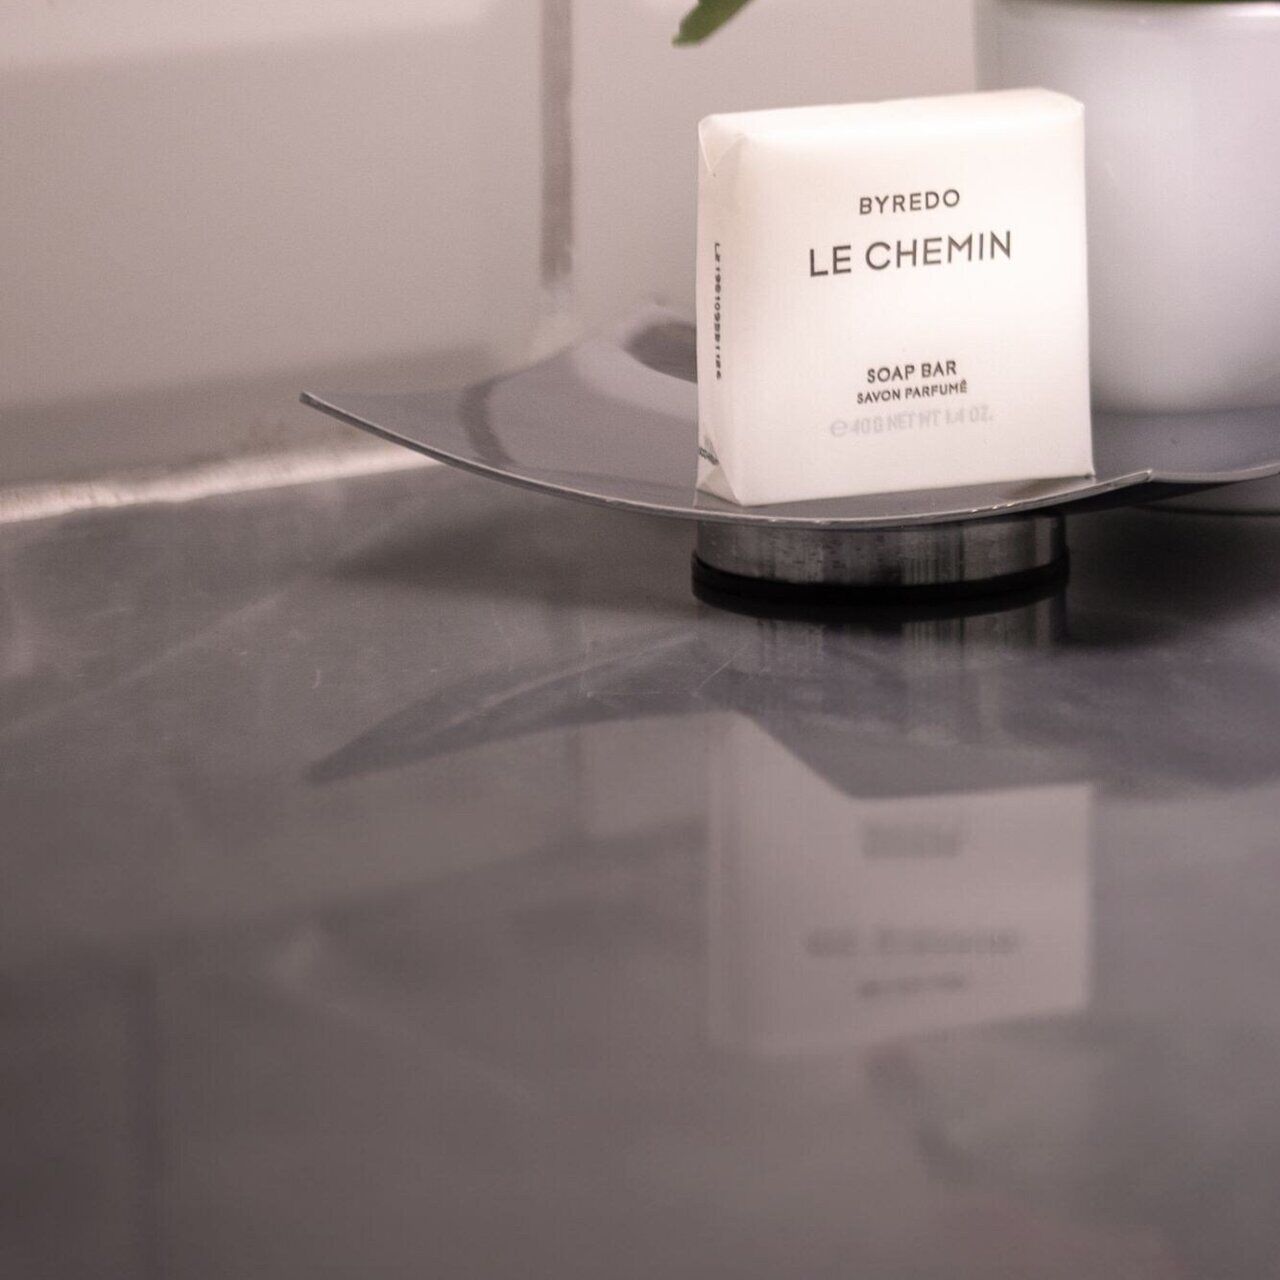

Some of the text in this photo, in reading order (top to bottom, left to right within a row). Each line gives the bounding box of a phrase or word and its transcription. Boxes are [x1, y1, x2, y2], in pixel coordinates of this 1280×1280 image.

[858, 188, 961, 216] BYREDO
[808, 229, 1012, 278] LE CHEMIN
[866, 359, 958, 384] SOAP BAR
[856, 378, 968, 405] SAVON PARFUMÉ
